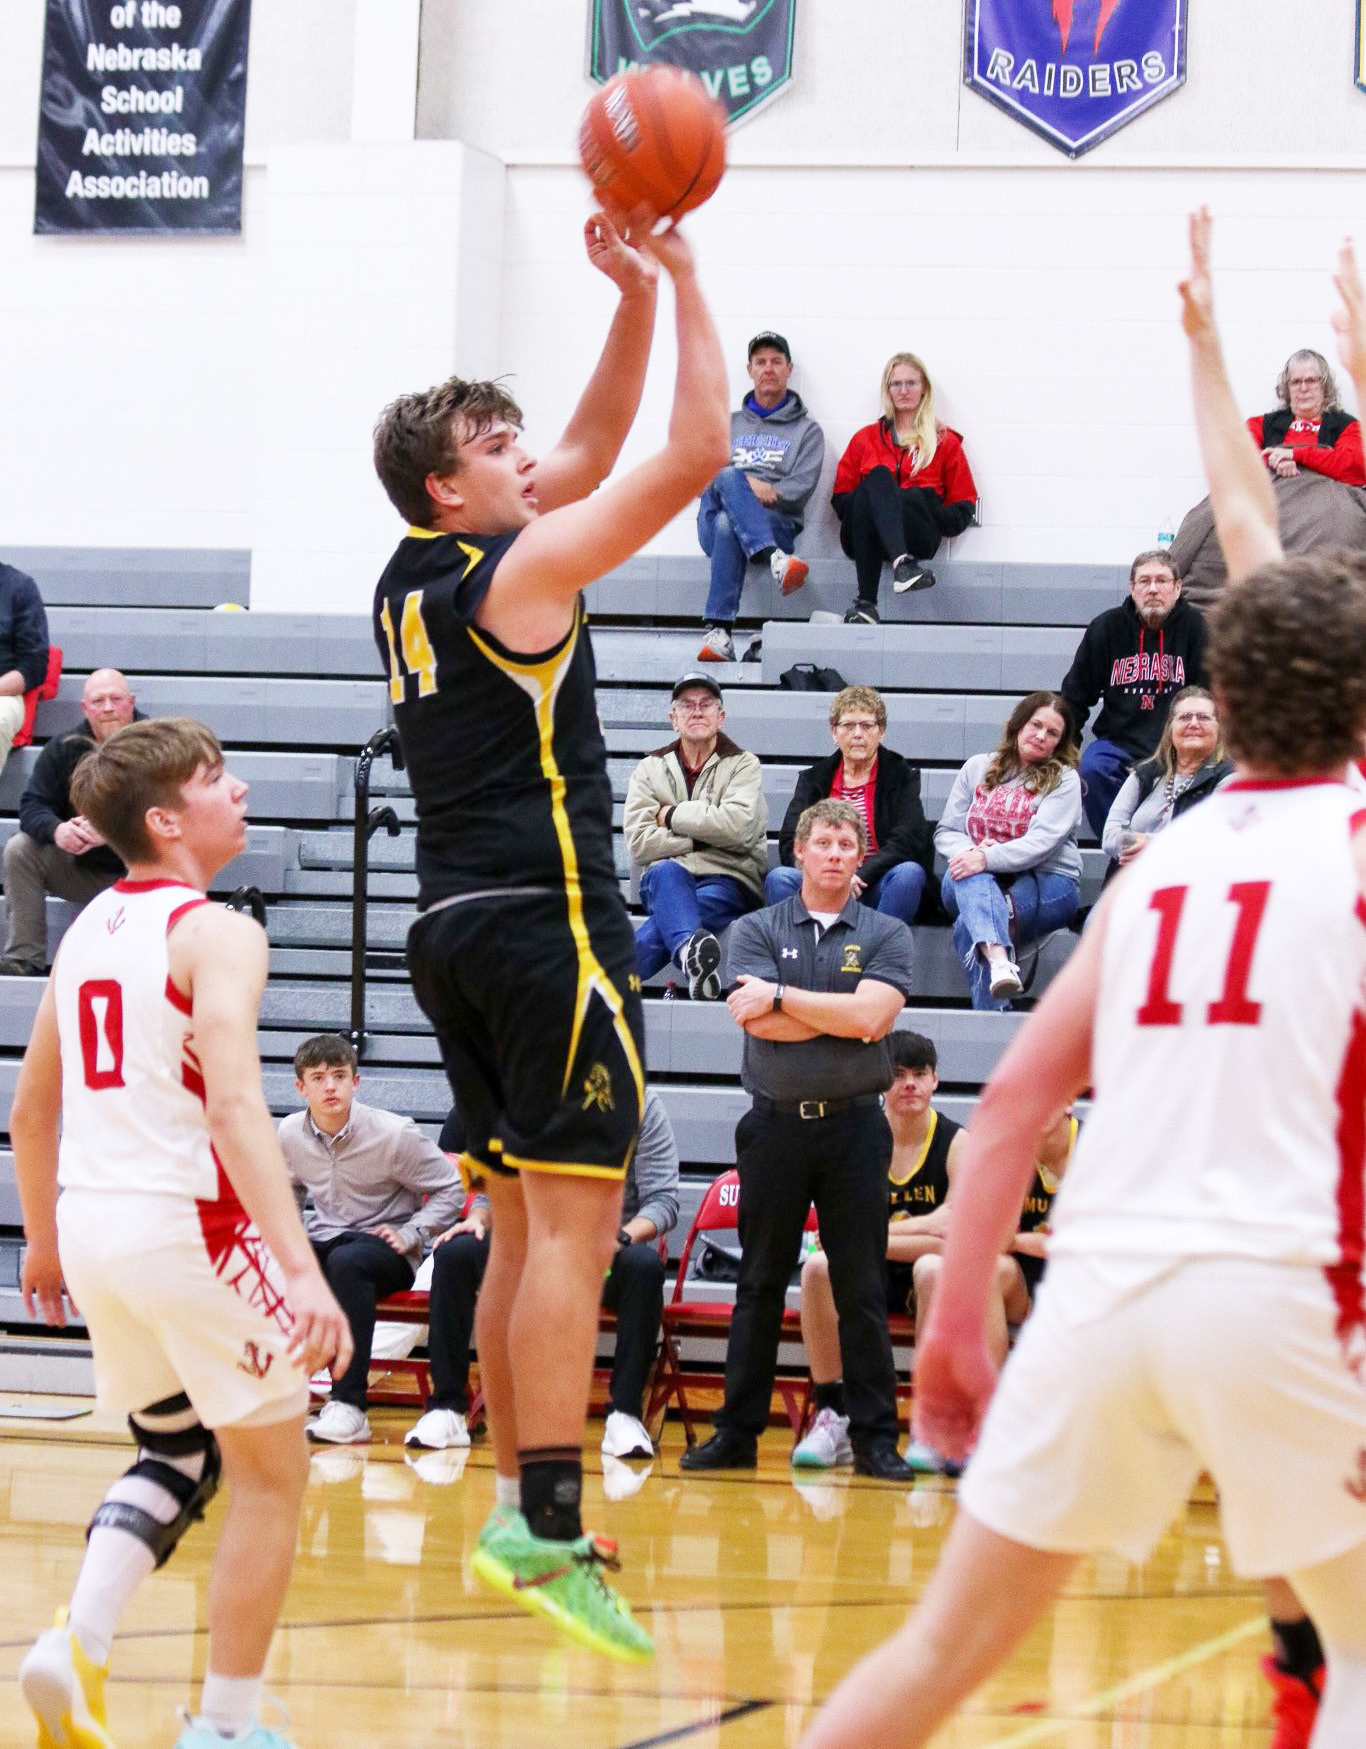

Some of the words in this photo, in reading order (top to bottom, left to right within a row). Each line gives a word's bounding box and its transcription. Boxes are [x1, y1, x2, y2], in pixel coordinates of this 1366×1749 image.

[110, 0, 137, 29] of
[140, 0, 182, 29] the
[86, 42, 202, 71] Nebraska
[986, 47, 1166, 98] RAIDERS
[100, 84, 184, 114] School
[82, 127, 197, 156] Activities
[65, 170, 209, 199] Association
[380, 589, 439, 706] 14
[1136, 880, 1273, 1026] 11
[78, 979, 126, 1092] 0
